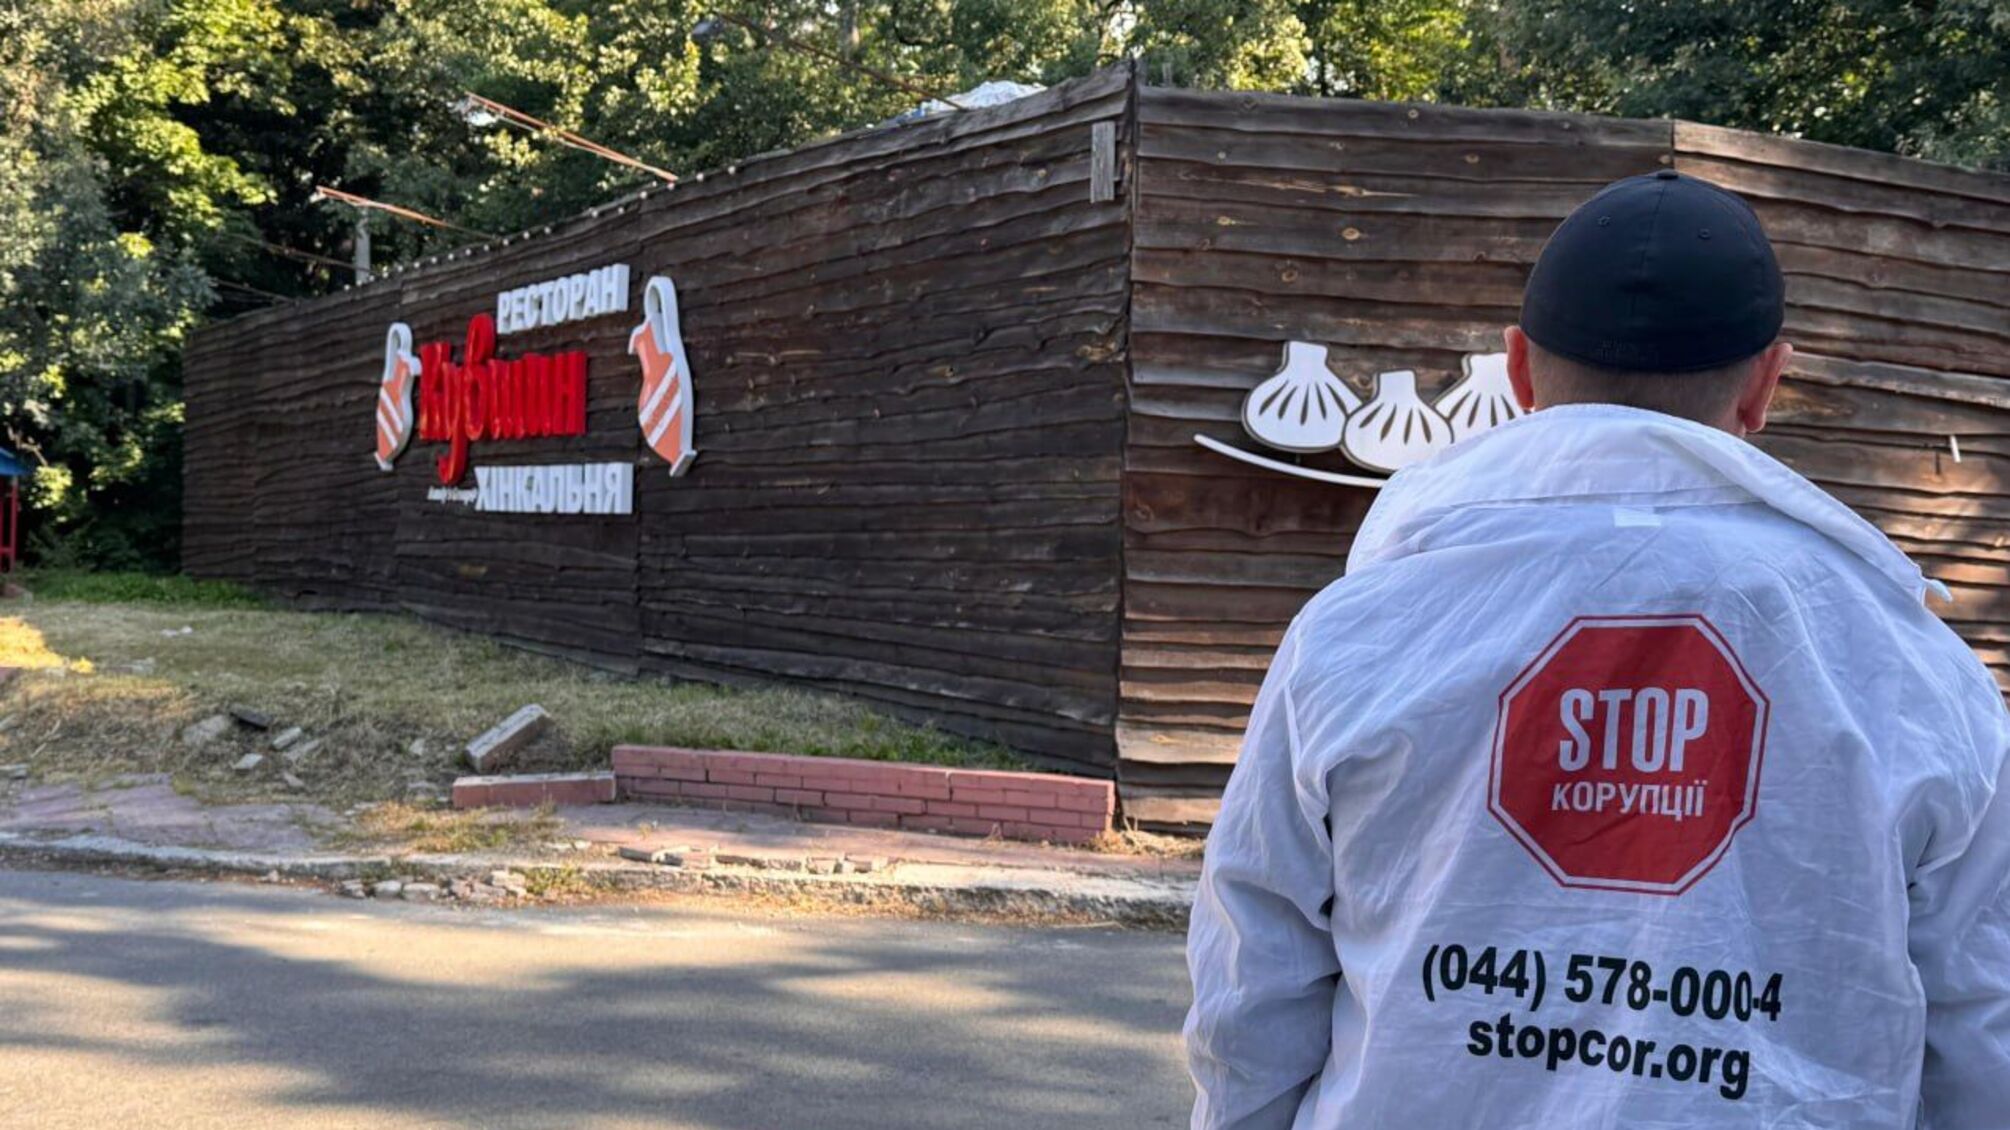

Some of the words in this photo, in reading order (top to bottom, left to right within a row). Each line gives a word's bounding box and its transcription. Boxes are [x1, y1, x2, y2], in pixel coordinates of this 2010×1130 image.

[497, 264, 630, 334] РЕСТОРАН
[474, 463, 633, 514] ХІНКАЛЬНЯ
[1558, 687, 1709, 772] STOP
[1551, 780, 1707, 821] КОРУПЦІЇ
[1422, 944, 1546, 1012] (044)
[1466, 1013, 1751, 1100] stopcor.org
